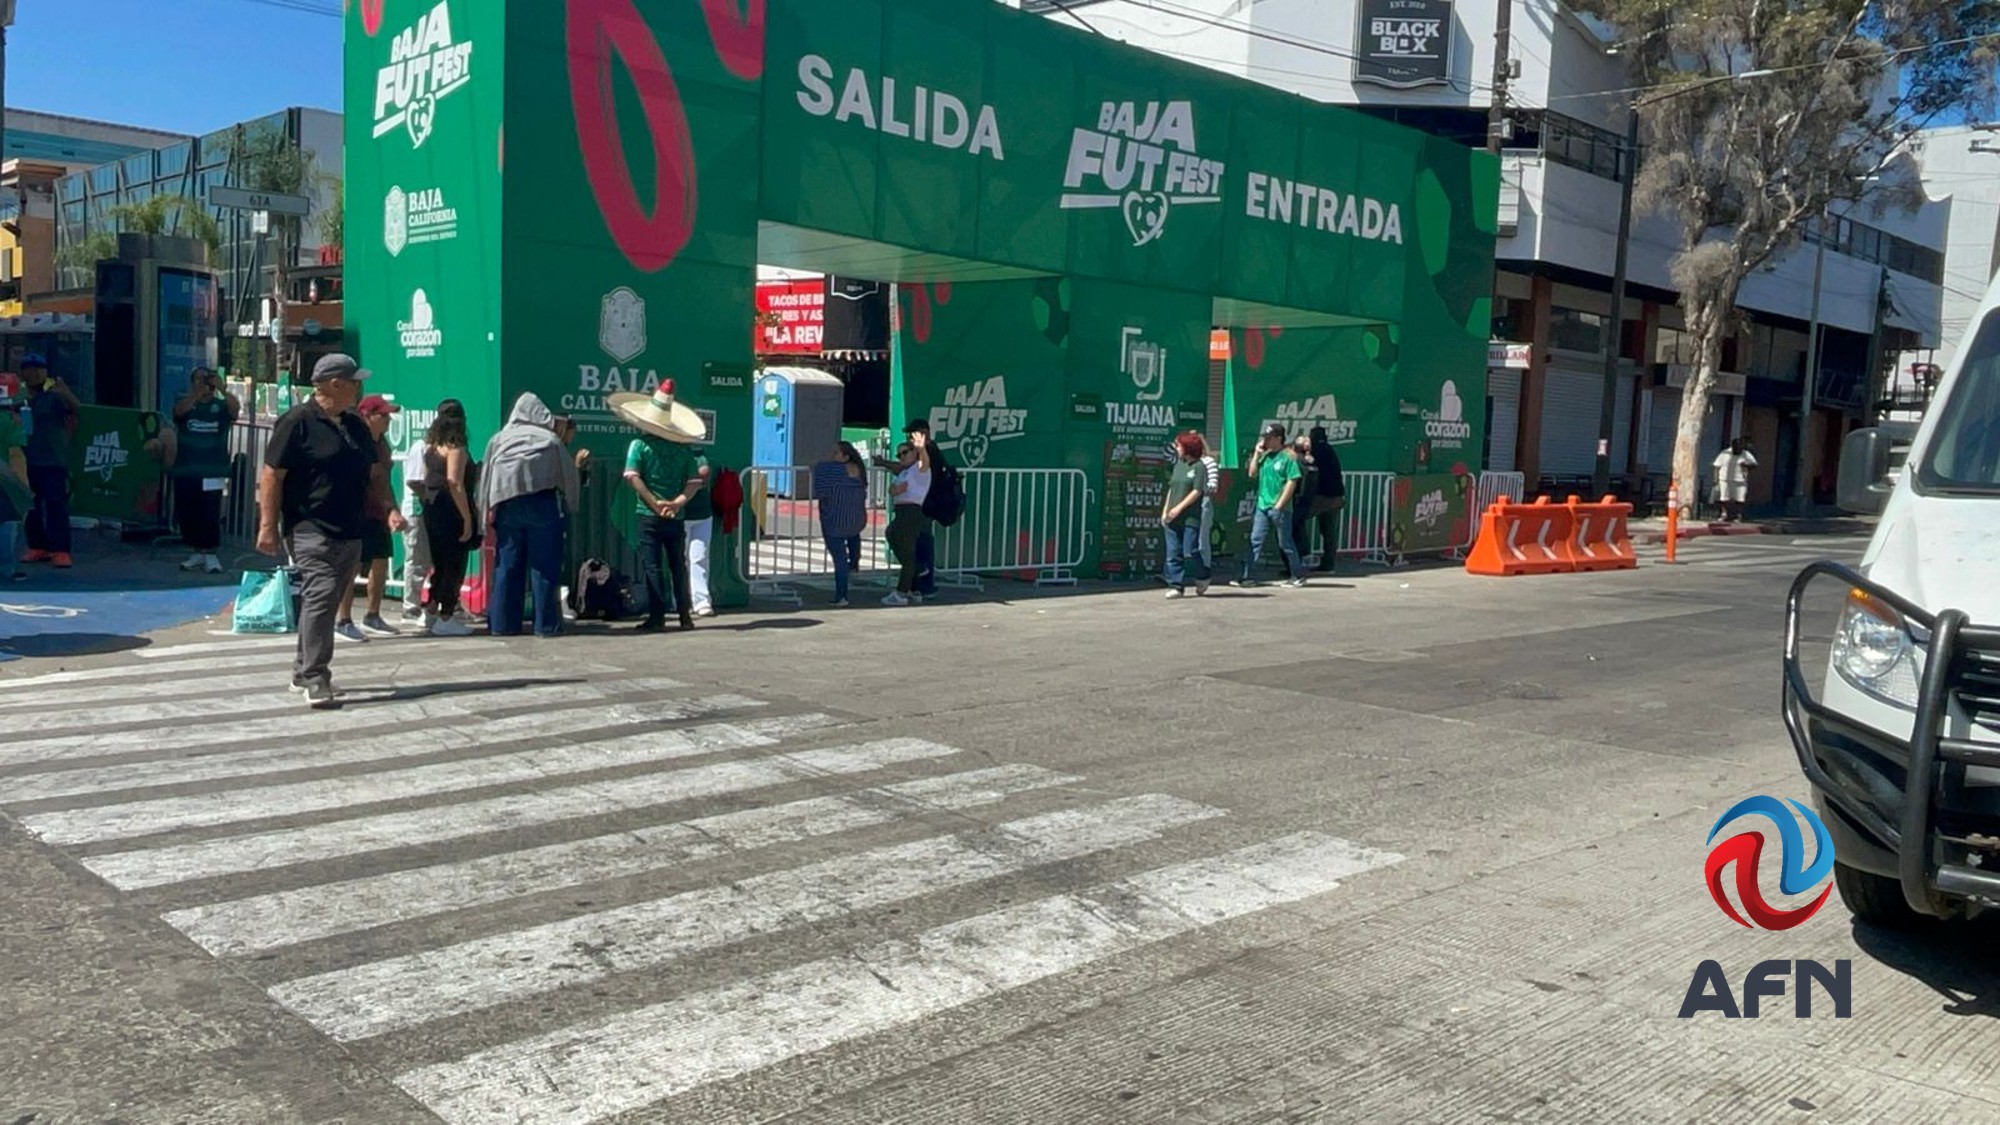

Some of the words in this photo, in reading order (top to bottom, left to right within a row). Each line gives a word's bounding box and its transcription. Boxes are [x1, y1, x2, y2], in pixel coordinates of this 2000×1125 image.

[390, 0, 451, 63] BAJA
[1371, 21, 1440, 37] BLACK
[374, 54, 431, 121] FUT
[430, 40, 472, 92] FEST
[796, 54, 1004, 160] SALIDA
[1097, 101, 1196, 153] BAJA
[1063, 127, 1164, 191] FUT
[1164, 151, 1225, 194] FEST
[408, 187, 444, 213] BAJA
[1246, 171, 1403, 250] ENTRADA
[768, 294, 798, 307] TACOS
[579, 364, 661, 393] BAJA
[710, 376, 743, 387] SALIDA
[944, 375, 1007, 407] BAJA
[1105, 402, 1176, 427] TIJUANA
[1276, 393, 1338, 420] BAJA
[575, 422, 616, 434] BIERNO
[929, 406, 986, 441] FUT
[985, 408, 1028, 435] FEST
